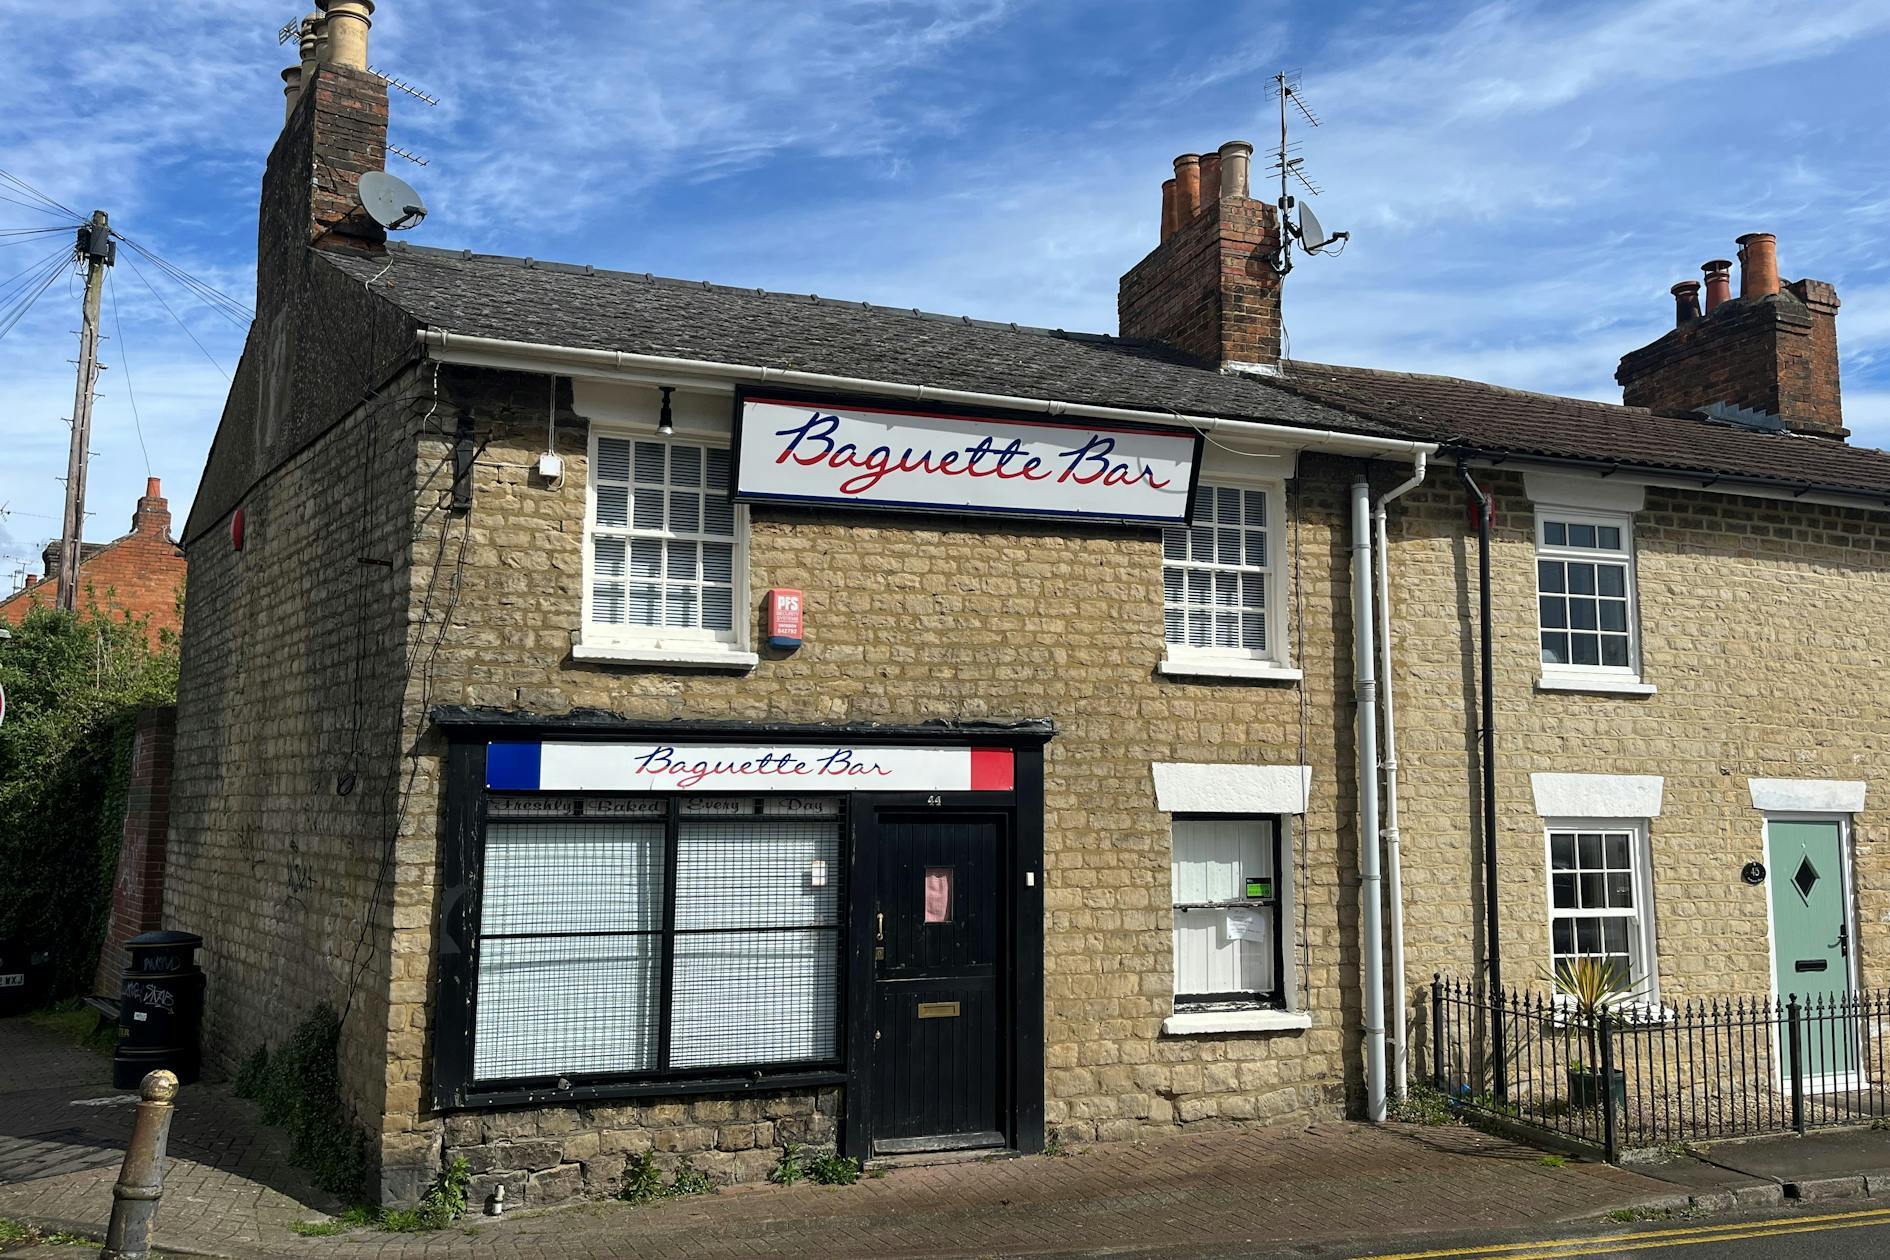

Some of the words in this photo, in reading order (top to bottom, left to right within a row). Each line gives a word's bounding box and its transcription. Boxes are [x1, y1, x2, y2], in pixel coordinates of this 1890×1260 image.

[775, 412, 1053, 494] Baguette
[1058, 434, 1171, 490] Bar
[778, 596, 799, 610] PFS
[634, 746, 814, 788] Baguette
[817, 748, 893, 776] Bar
[494, 799, 572, 815] Freshly
[588, 800, 659, 812] Baked
[687, 798, 739, 814] Every
[779, 798, 823, 814] Day
[927, 795, 942, 806] 44
